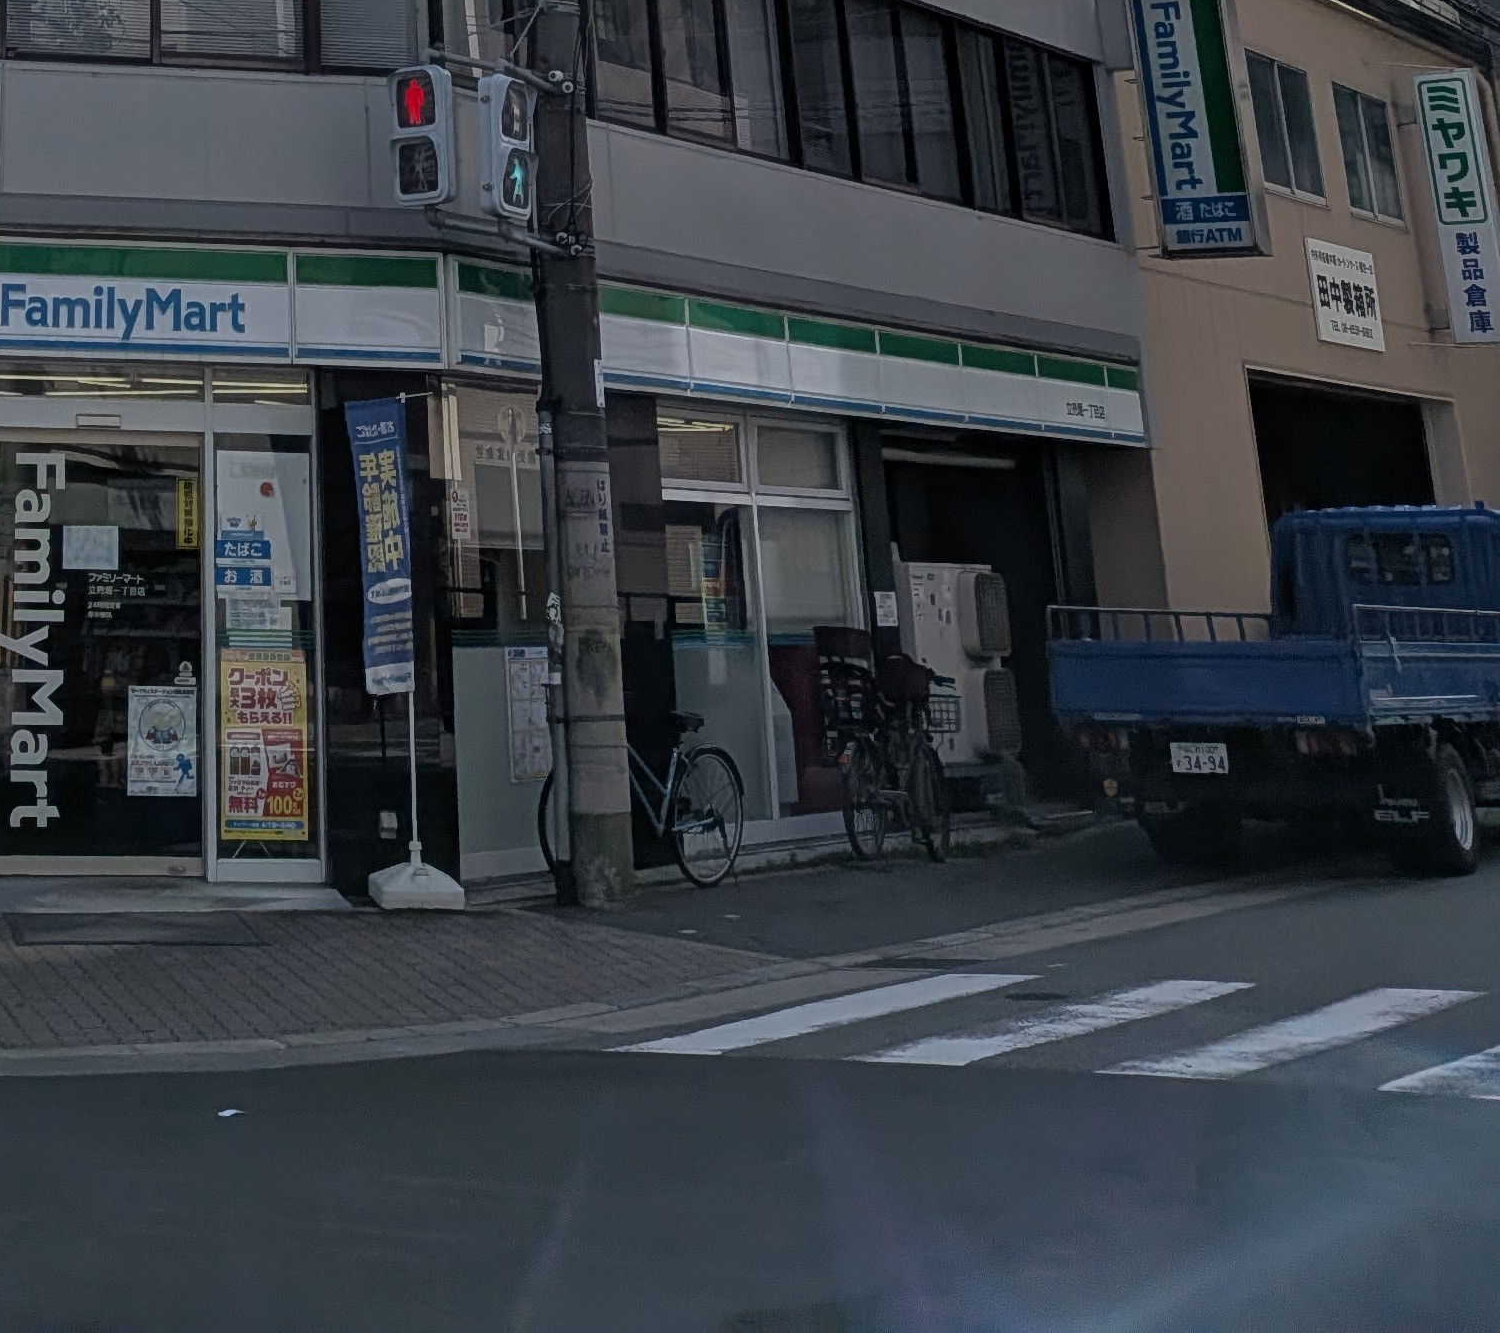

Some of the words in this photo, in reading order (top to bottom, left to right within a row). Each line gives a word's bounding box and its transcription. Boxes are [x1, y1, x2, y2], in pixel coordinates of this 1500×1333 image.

[1150, 0, 1204, 191] FamilyMart
[1426, 85, 1477, 218] ミヤワキ
[1176, 201, 1195, 221] 酒
[1199, 200, 1238, 219] たばこ
[1175, 227, 1244, 245] 銀行ATM
[1455, 231, 1495, 335] 製品倉庫
[1316, 274, 1378, 321] 田中製箱所
[0, 283, 246, 340] FamilyMart
[223, 541, 263, 557] たばこ
[88, 572, 145, 585] ファミリーマート
[223, 568, 264, 584] お酒
[228, 667, 289, 686] クーポン
[240, 686, 278, 710] 3枚
[237, 710, 293, 725] もらえる!!
